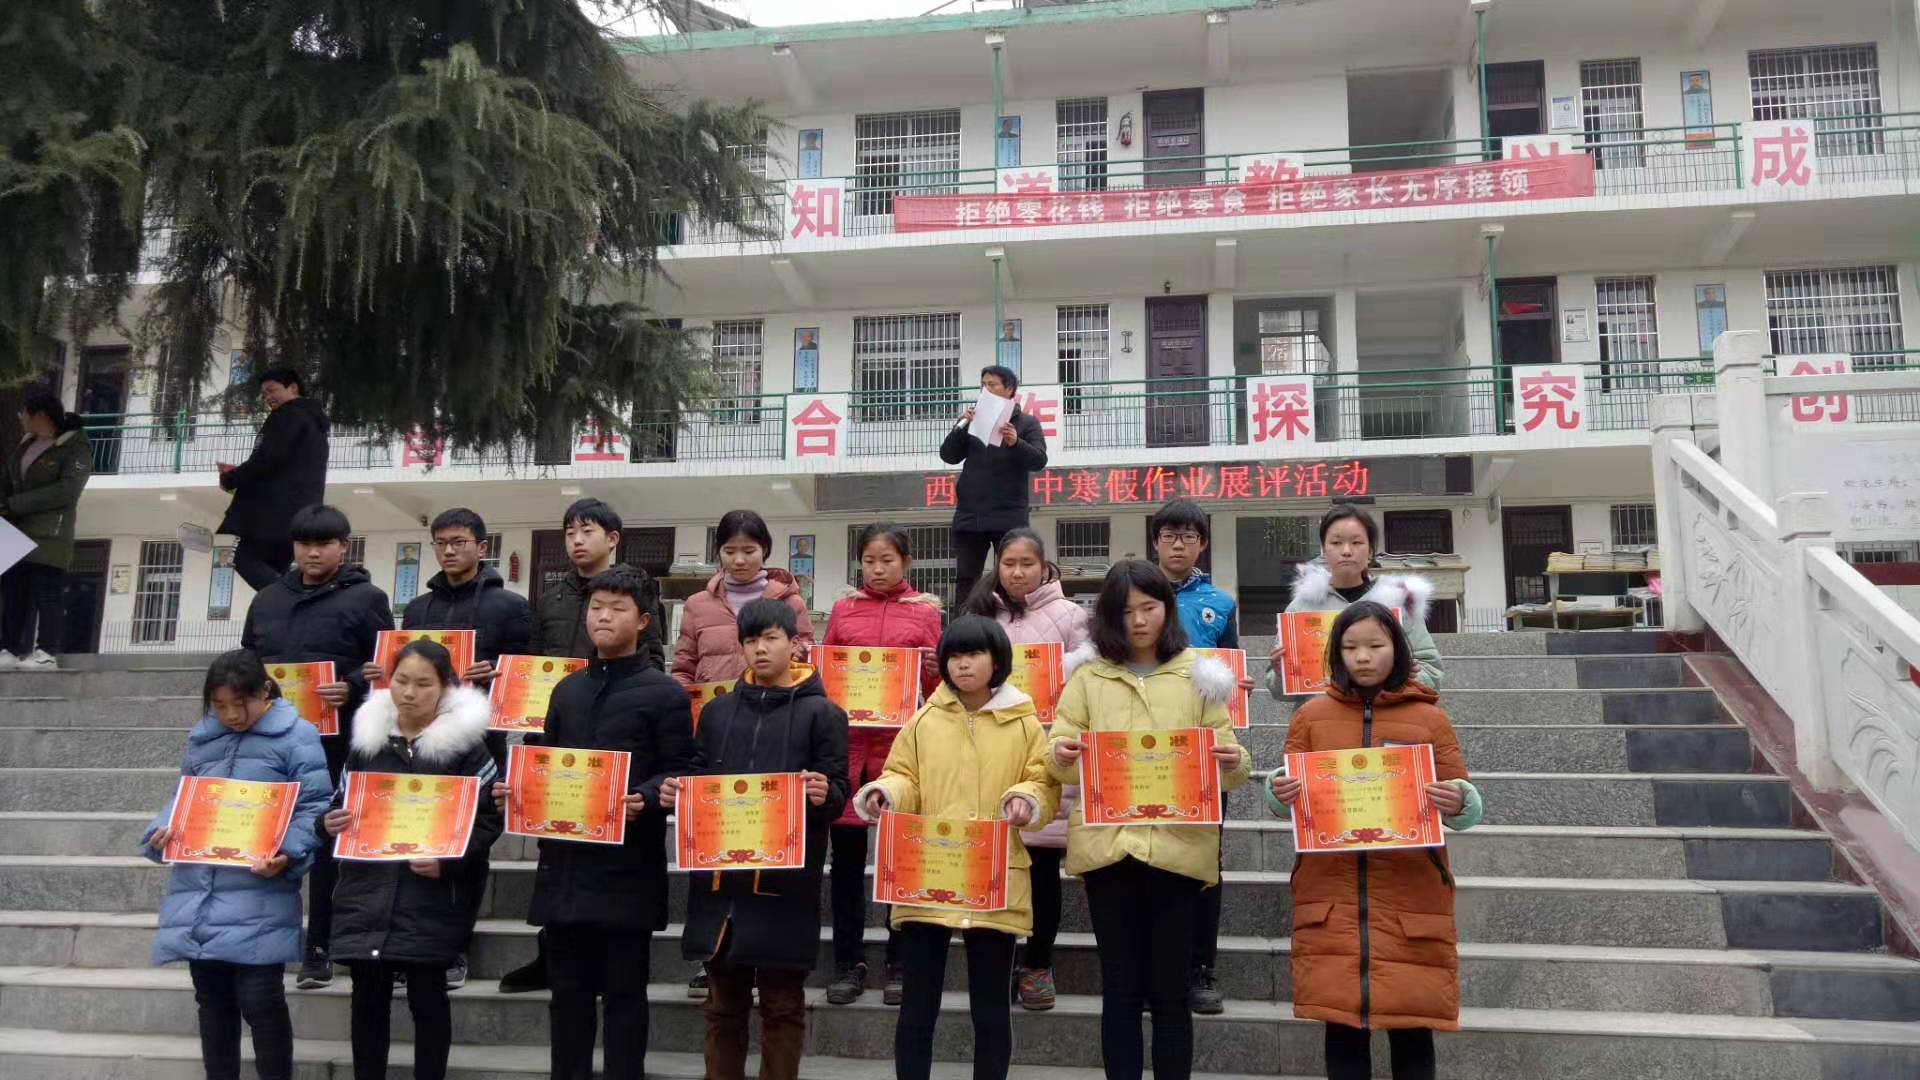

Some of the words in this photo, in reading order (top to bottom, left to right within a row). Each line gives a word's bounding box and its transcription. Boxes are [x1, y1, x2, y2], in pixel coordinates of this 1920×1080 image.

[1753, 127, 1811, 187] 成
[791, 184, 840, 238] 知
[953, 193, 1104, 226] 拒绝零花钱
[1125, 187, 1248, 219] 拒绝零食
[1267, 167, 1529, 212] 拒绝家长无序接领
[792, 399, 842, 457] 合
[1251, 383, 1310, 444] 探
[1519, 373, 1581, 433] 究
[924, 460, 1370, 507] 西中寒假作业展评活动
